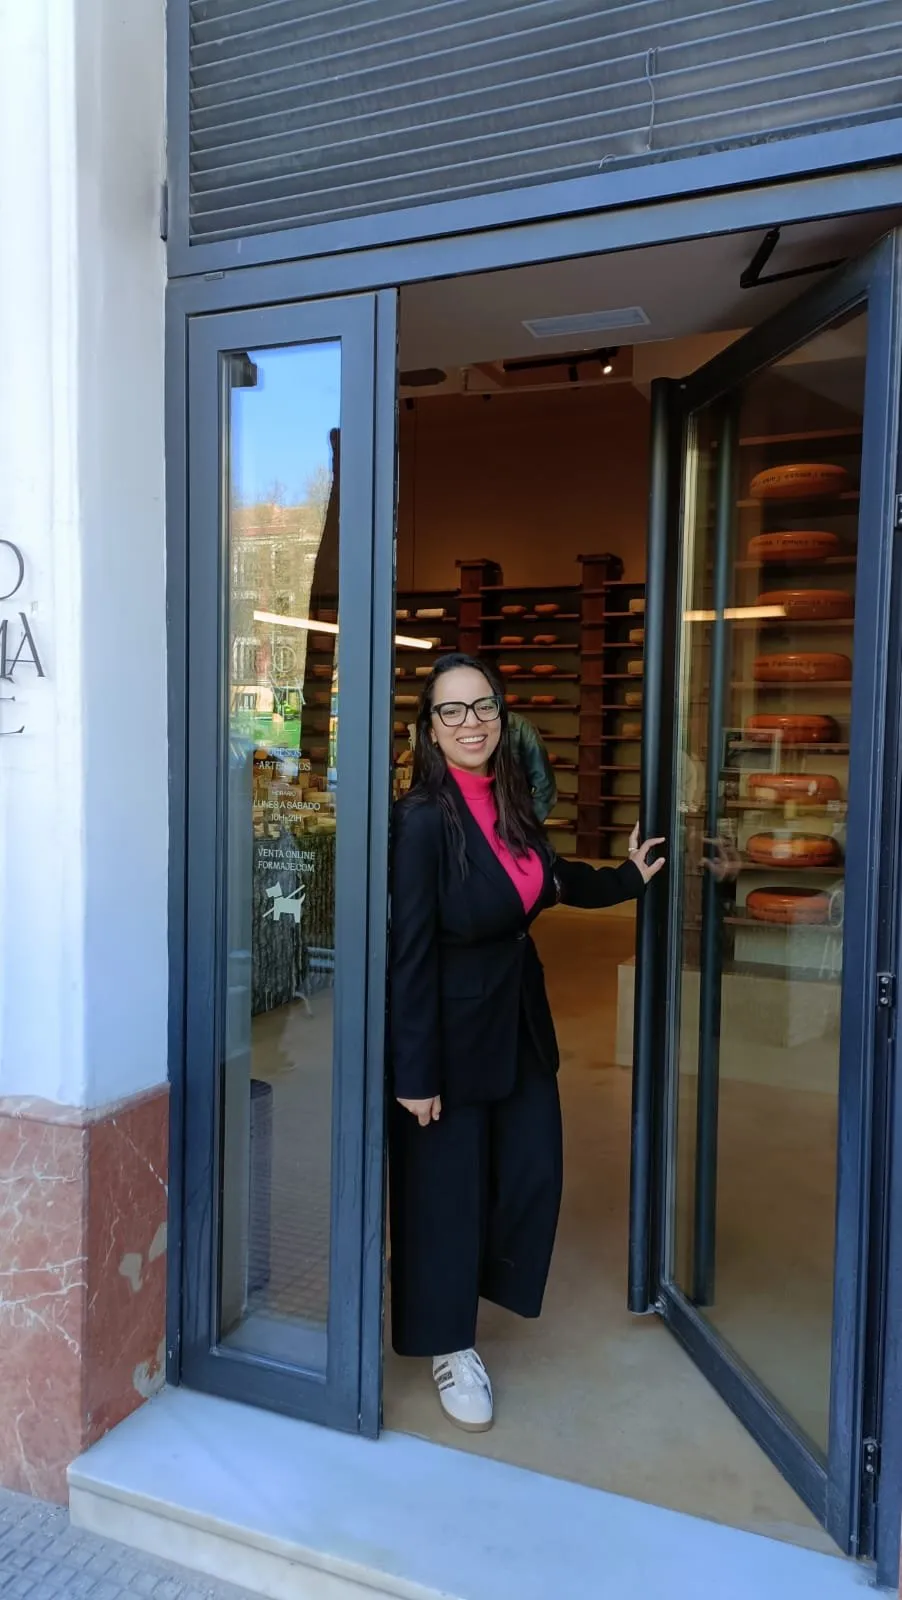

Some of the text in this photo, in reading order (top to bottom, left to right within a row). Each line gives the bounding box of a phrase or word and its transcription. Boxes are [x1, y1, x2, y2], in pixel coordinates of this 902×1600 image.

[258, 760, 311, 772] ARTEOS
[253, 799, 279, 809] LUNES
[279, 800, 286, 809] A
[257, 847, 316, 861] VENTA ONLINE
